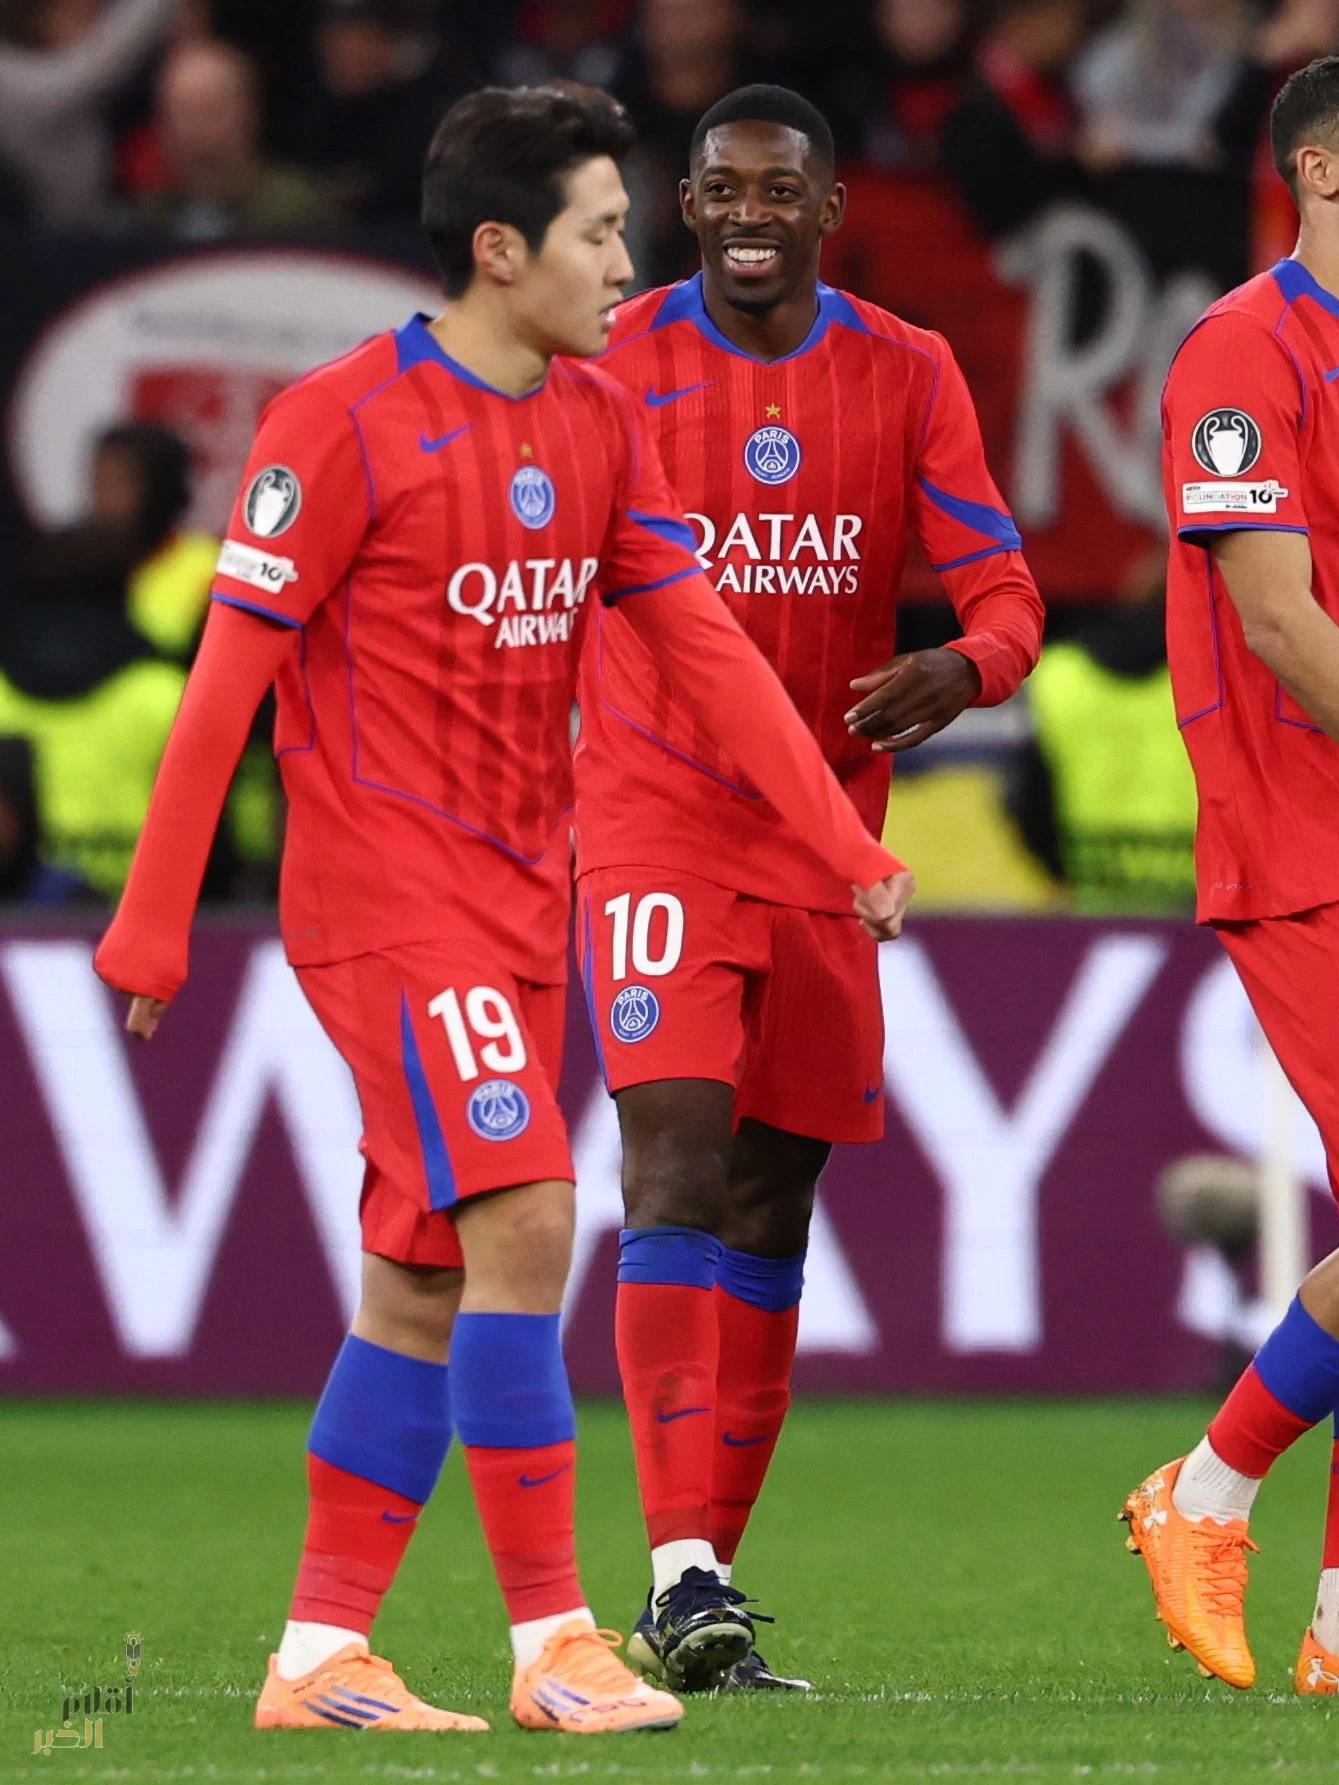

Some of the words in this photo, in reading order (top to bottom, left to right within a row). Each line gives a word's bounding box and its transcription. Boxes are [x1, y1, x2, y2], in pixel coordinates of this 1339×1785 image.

[754, 430, 790, 444] PARIS
[715, 563, 859, 595] AIRWAYS
[495, 607, 578, 649] AIRWA
[604, 892, 684, 981] 10
[617, 989, 649, 1005] PARIS
[428, 985, 527, 1082] 19
[0, 937, 1336, 1365] WAYS
